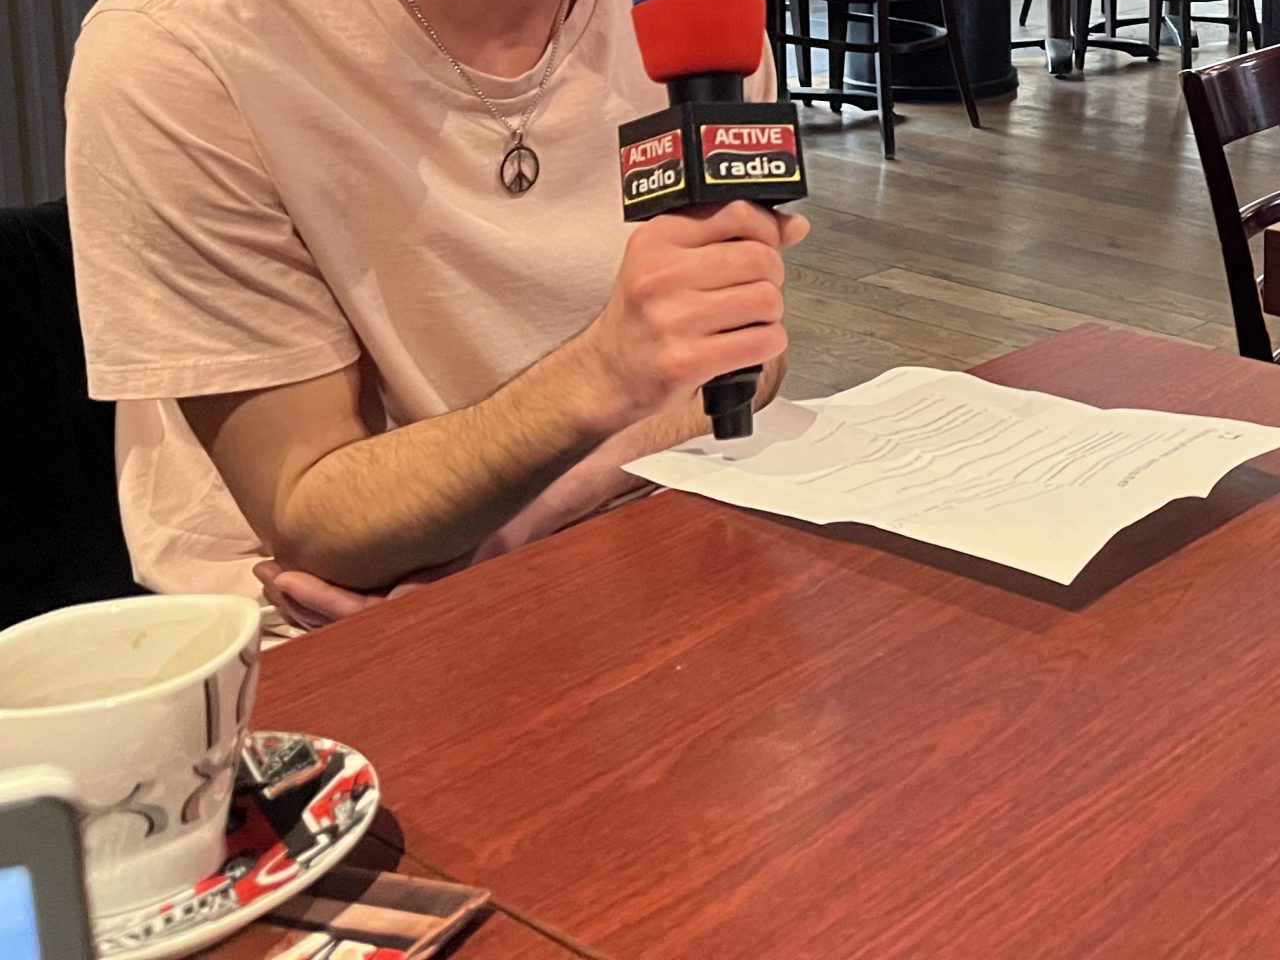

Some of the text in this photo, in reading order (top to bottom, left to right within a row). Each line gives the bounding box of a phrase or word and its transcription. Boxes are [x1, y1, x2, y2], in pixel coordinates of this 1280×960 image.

[714, 127, 783, 145] ACTIVE
[628, 135, 673, 166] ACTIVE
[719, 156, 786, 176] radio
[631, 167, 676, 195] radio
